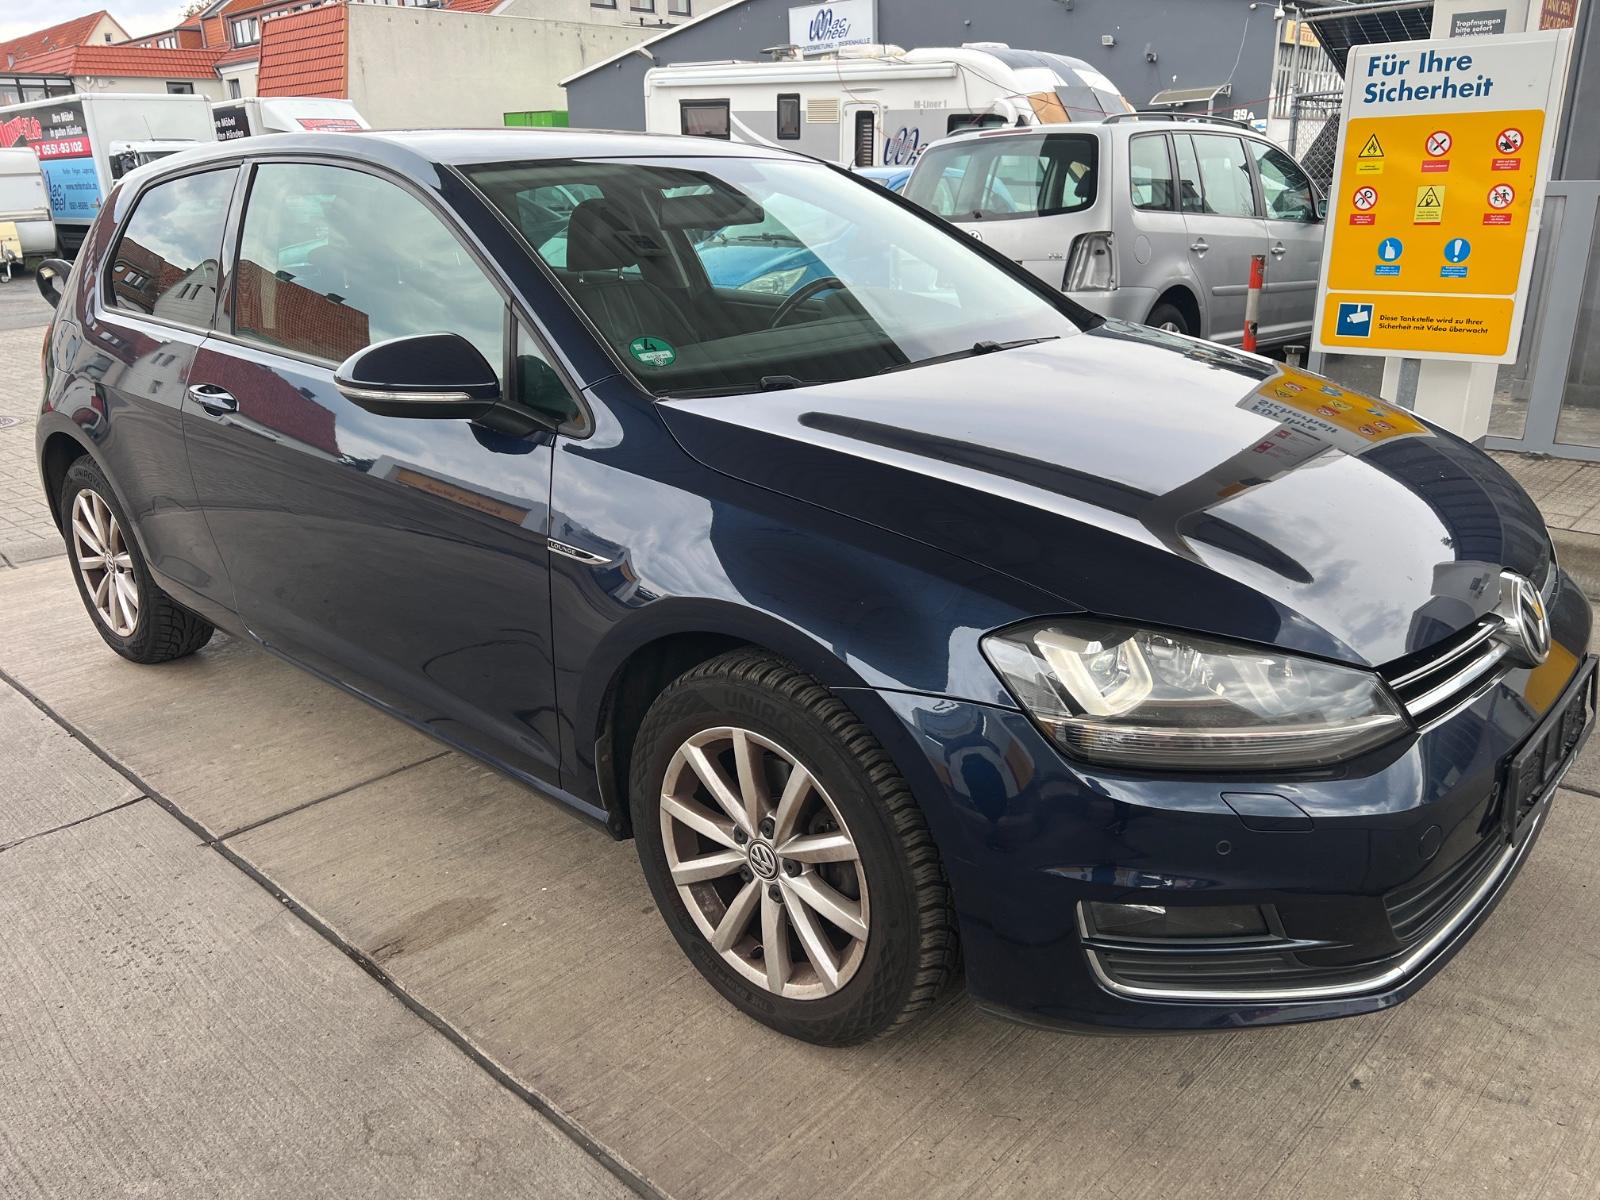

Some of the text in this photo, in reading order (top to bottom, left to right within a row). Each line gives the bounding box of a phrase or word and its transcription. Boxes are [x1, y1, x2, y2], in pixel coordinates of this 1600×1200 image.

[1456, 19, 1501, 28] Tropfmengen
[1367, 49, 1473, 78] Für Ihre
[1363, 74, 1494, 104] Sicherheit
[1379, 314, 1398, 322] Diese
[1400, 315, 1434, 323] Tankstelle
[1436, 316, 1453, 324] wird
[1449, 326, 1488, 334] überwacht
[549, 541, 577, 556] LOUNGE
